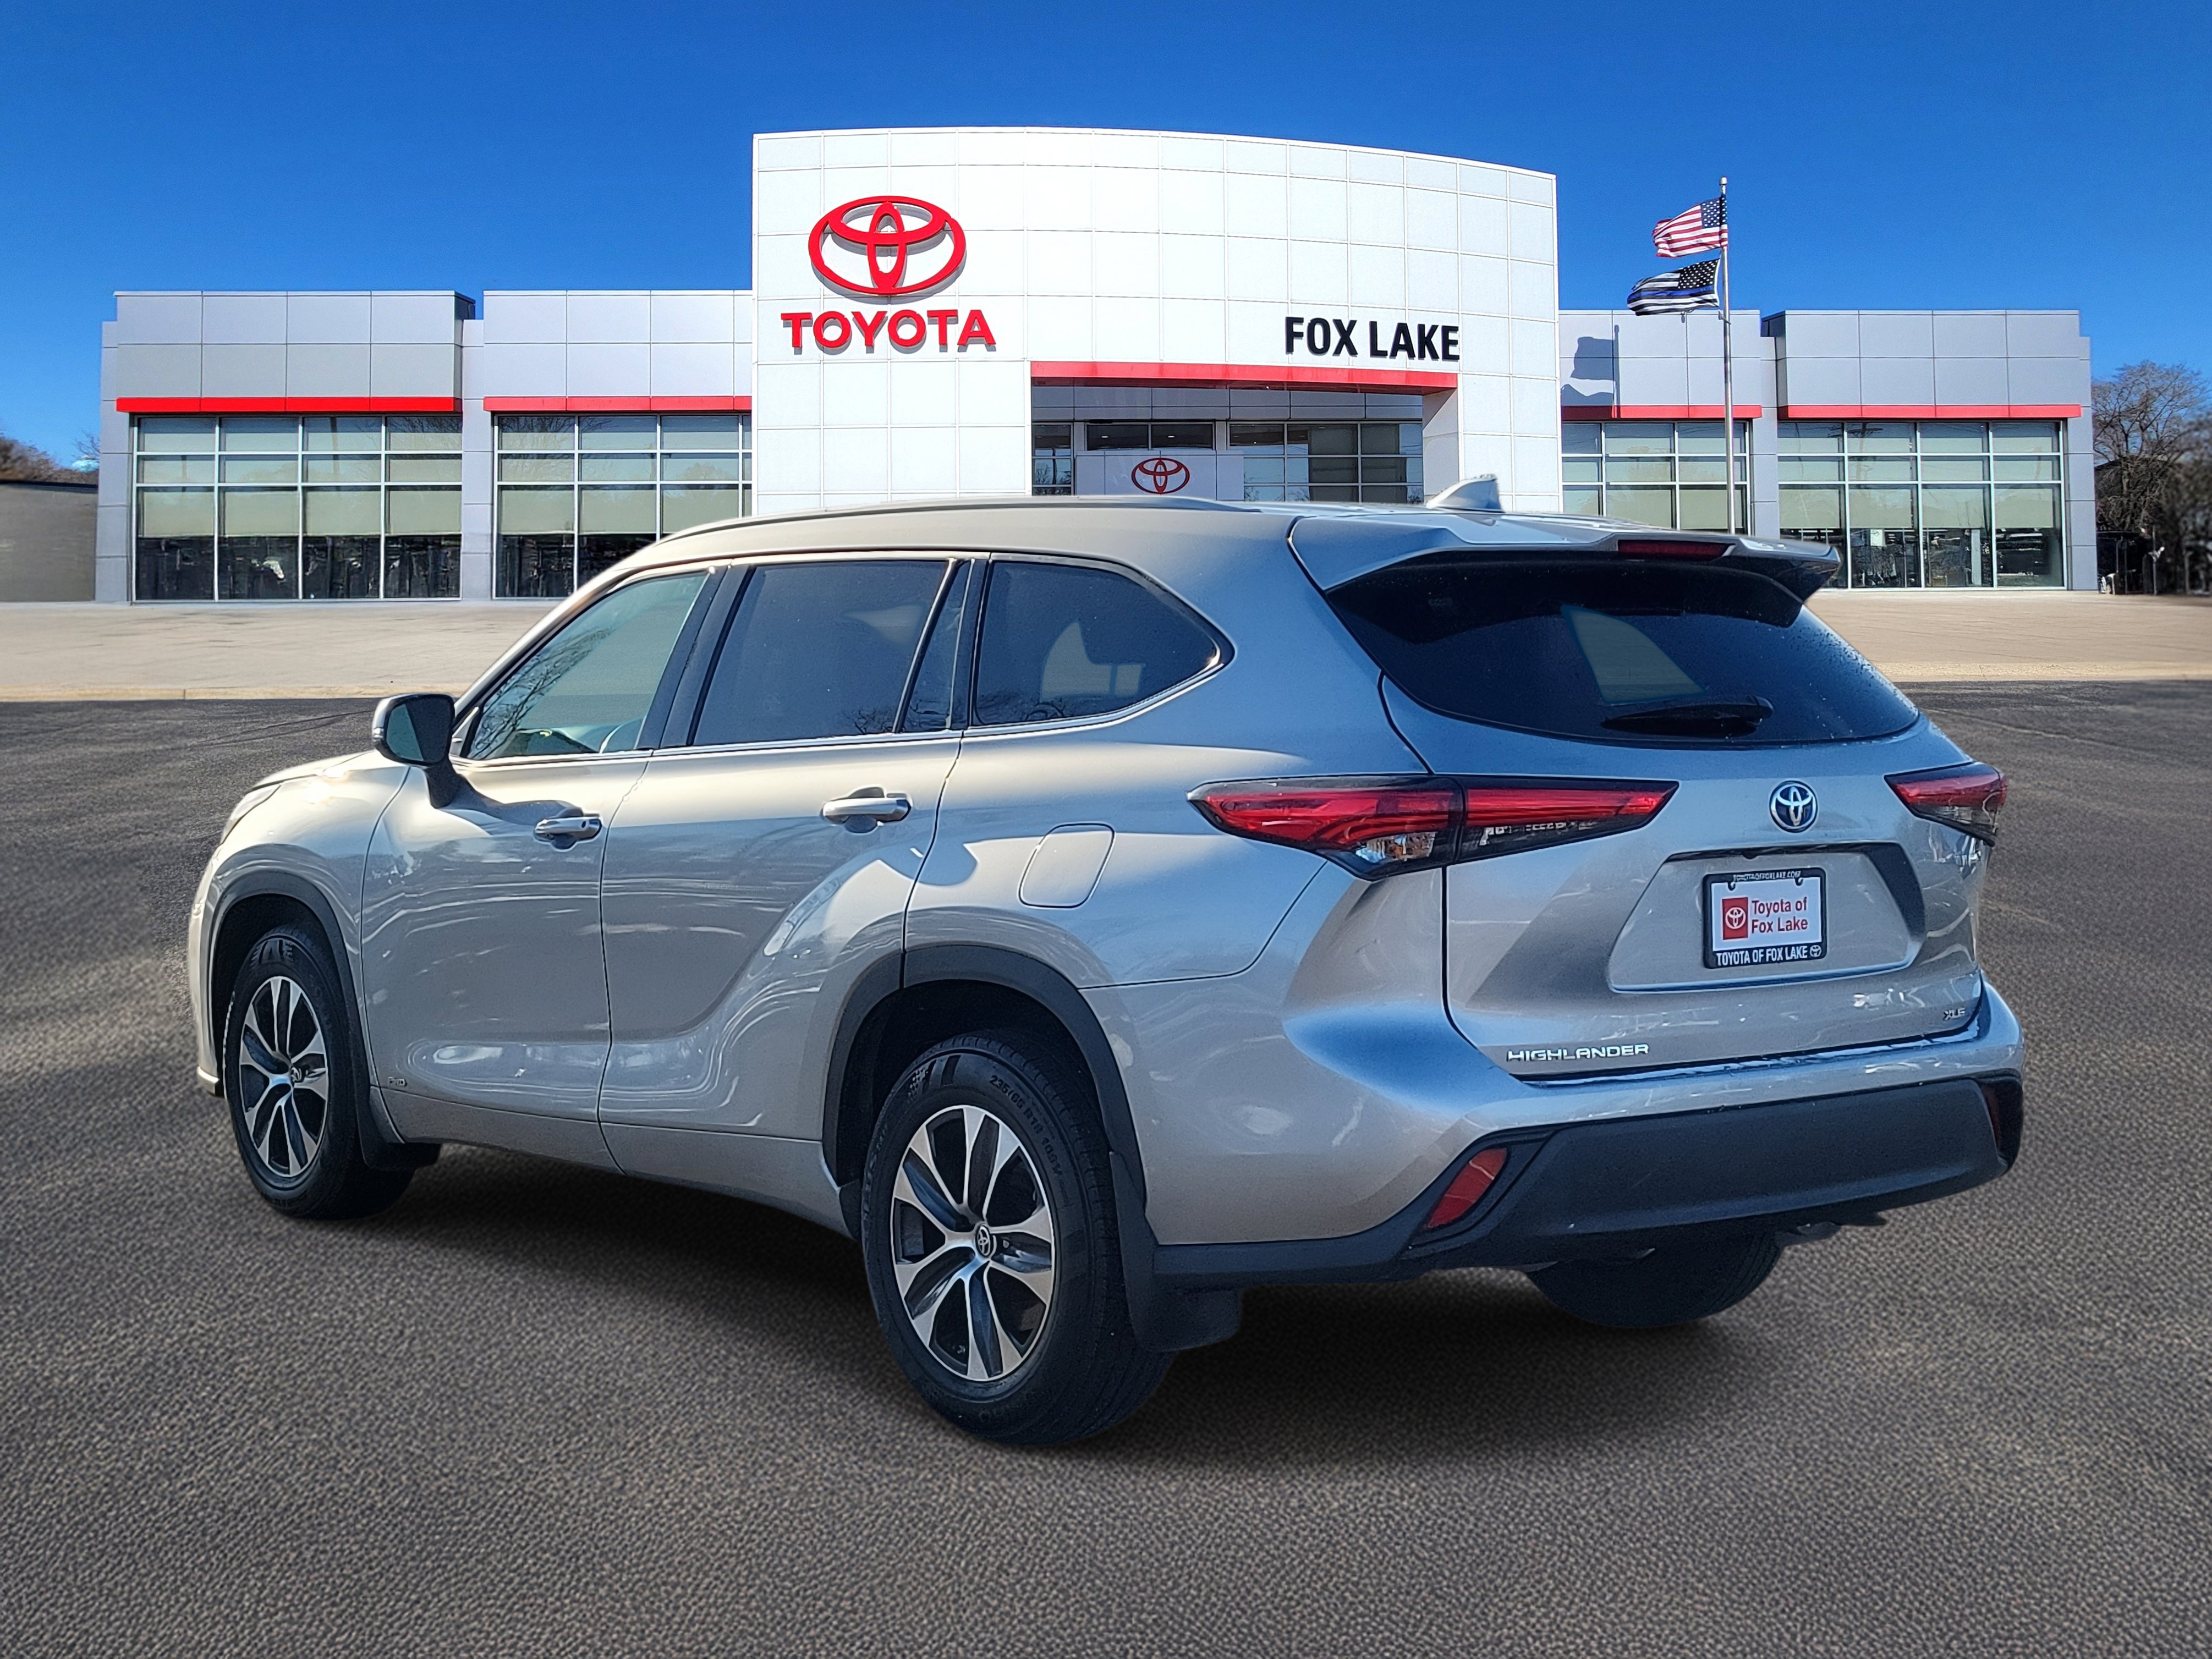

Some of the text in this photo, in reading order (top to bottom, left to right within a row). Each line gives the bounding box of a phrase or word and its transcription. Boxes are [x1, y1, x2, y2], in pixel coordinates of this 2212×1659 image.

[781, 310, 996, 353] TOYOTA
[1285, 317, 1460, 361] FOX LAKE
[1752, 897, 1807, 918] Toyota of
[1752, 916, 1808, 934] Fox Lake
[1716, 946, 1808, 966] TOYOTA OF FOX LAKE
[1507, 1043, 1649, 1062] HIGHLANDER
